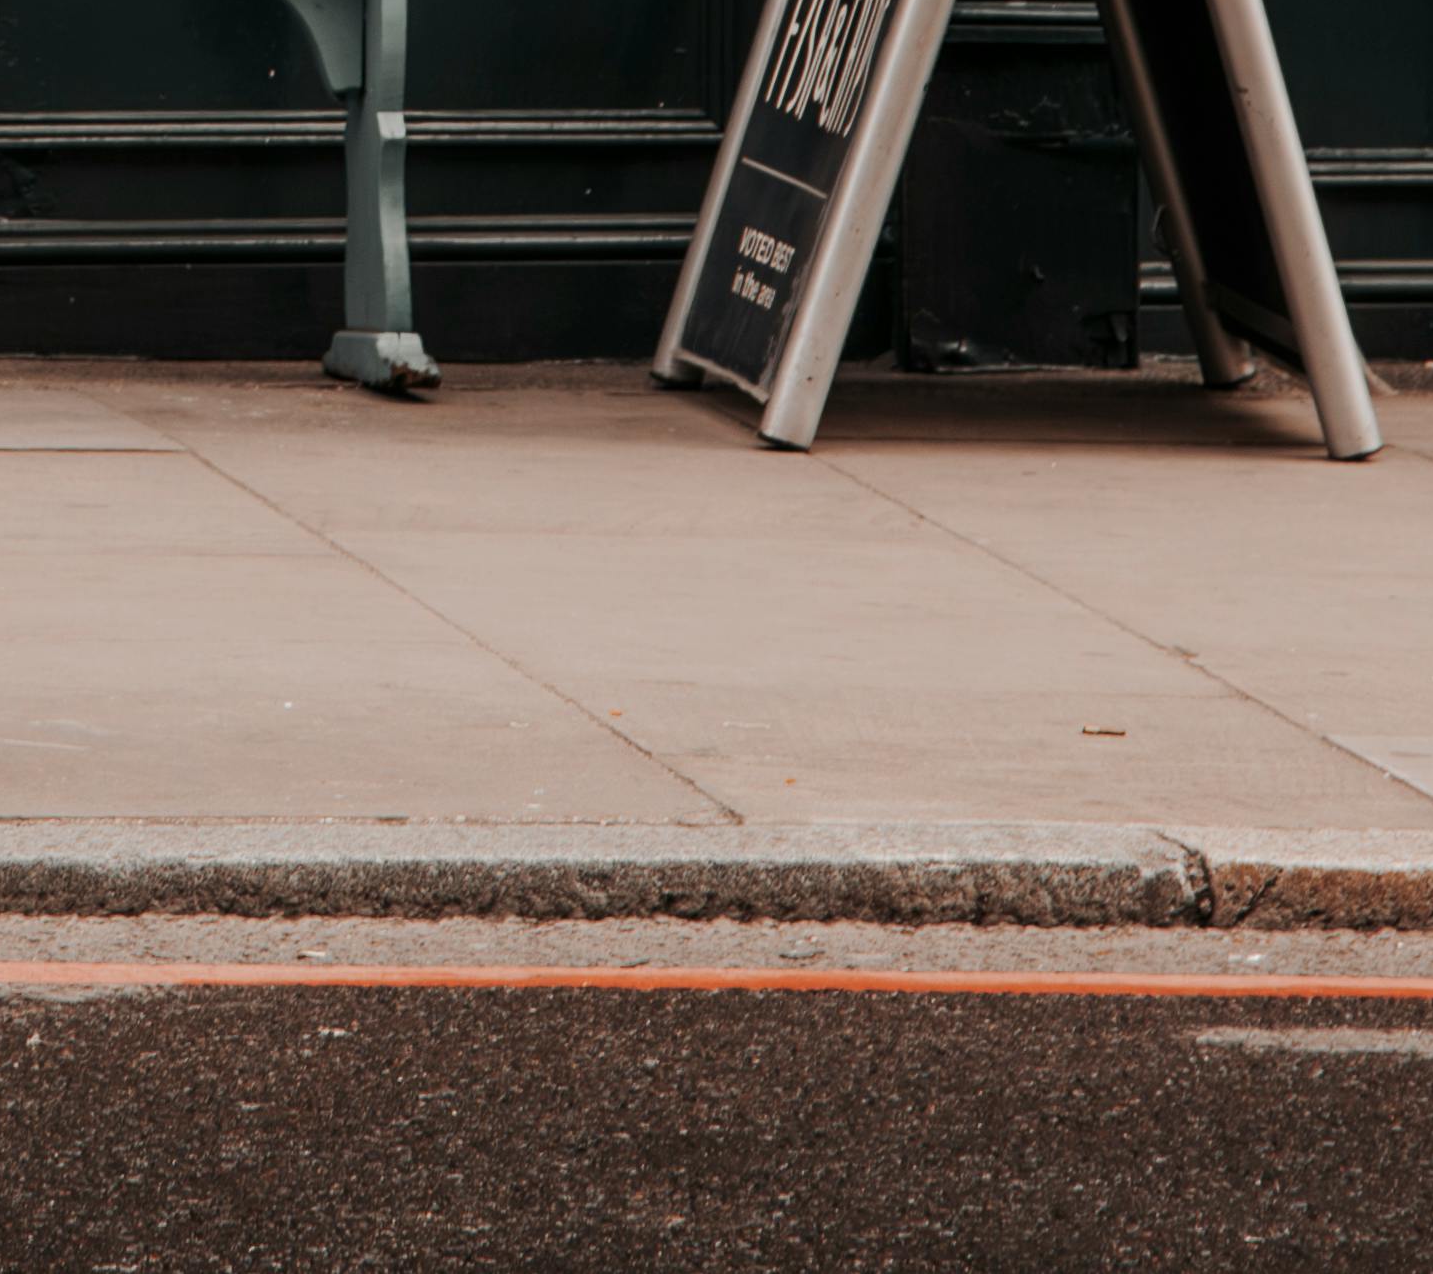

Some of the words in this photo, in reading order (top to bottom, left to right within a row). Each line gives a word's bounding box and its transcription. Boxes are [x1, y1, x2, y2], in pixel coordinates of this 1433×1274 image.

[739, 227, 775, 265] VOTED
[770, 241, 796, 273] BEST
[732, 266, 744, 295] in
[741, 271, 760, 301] the
